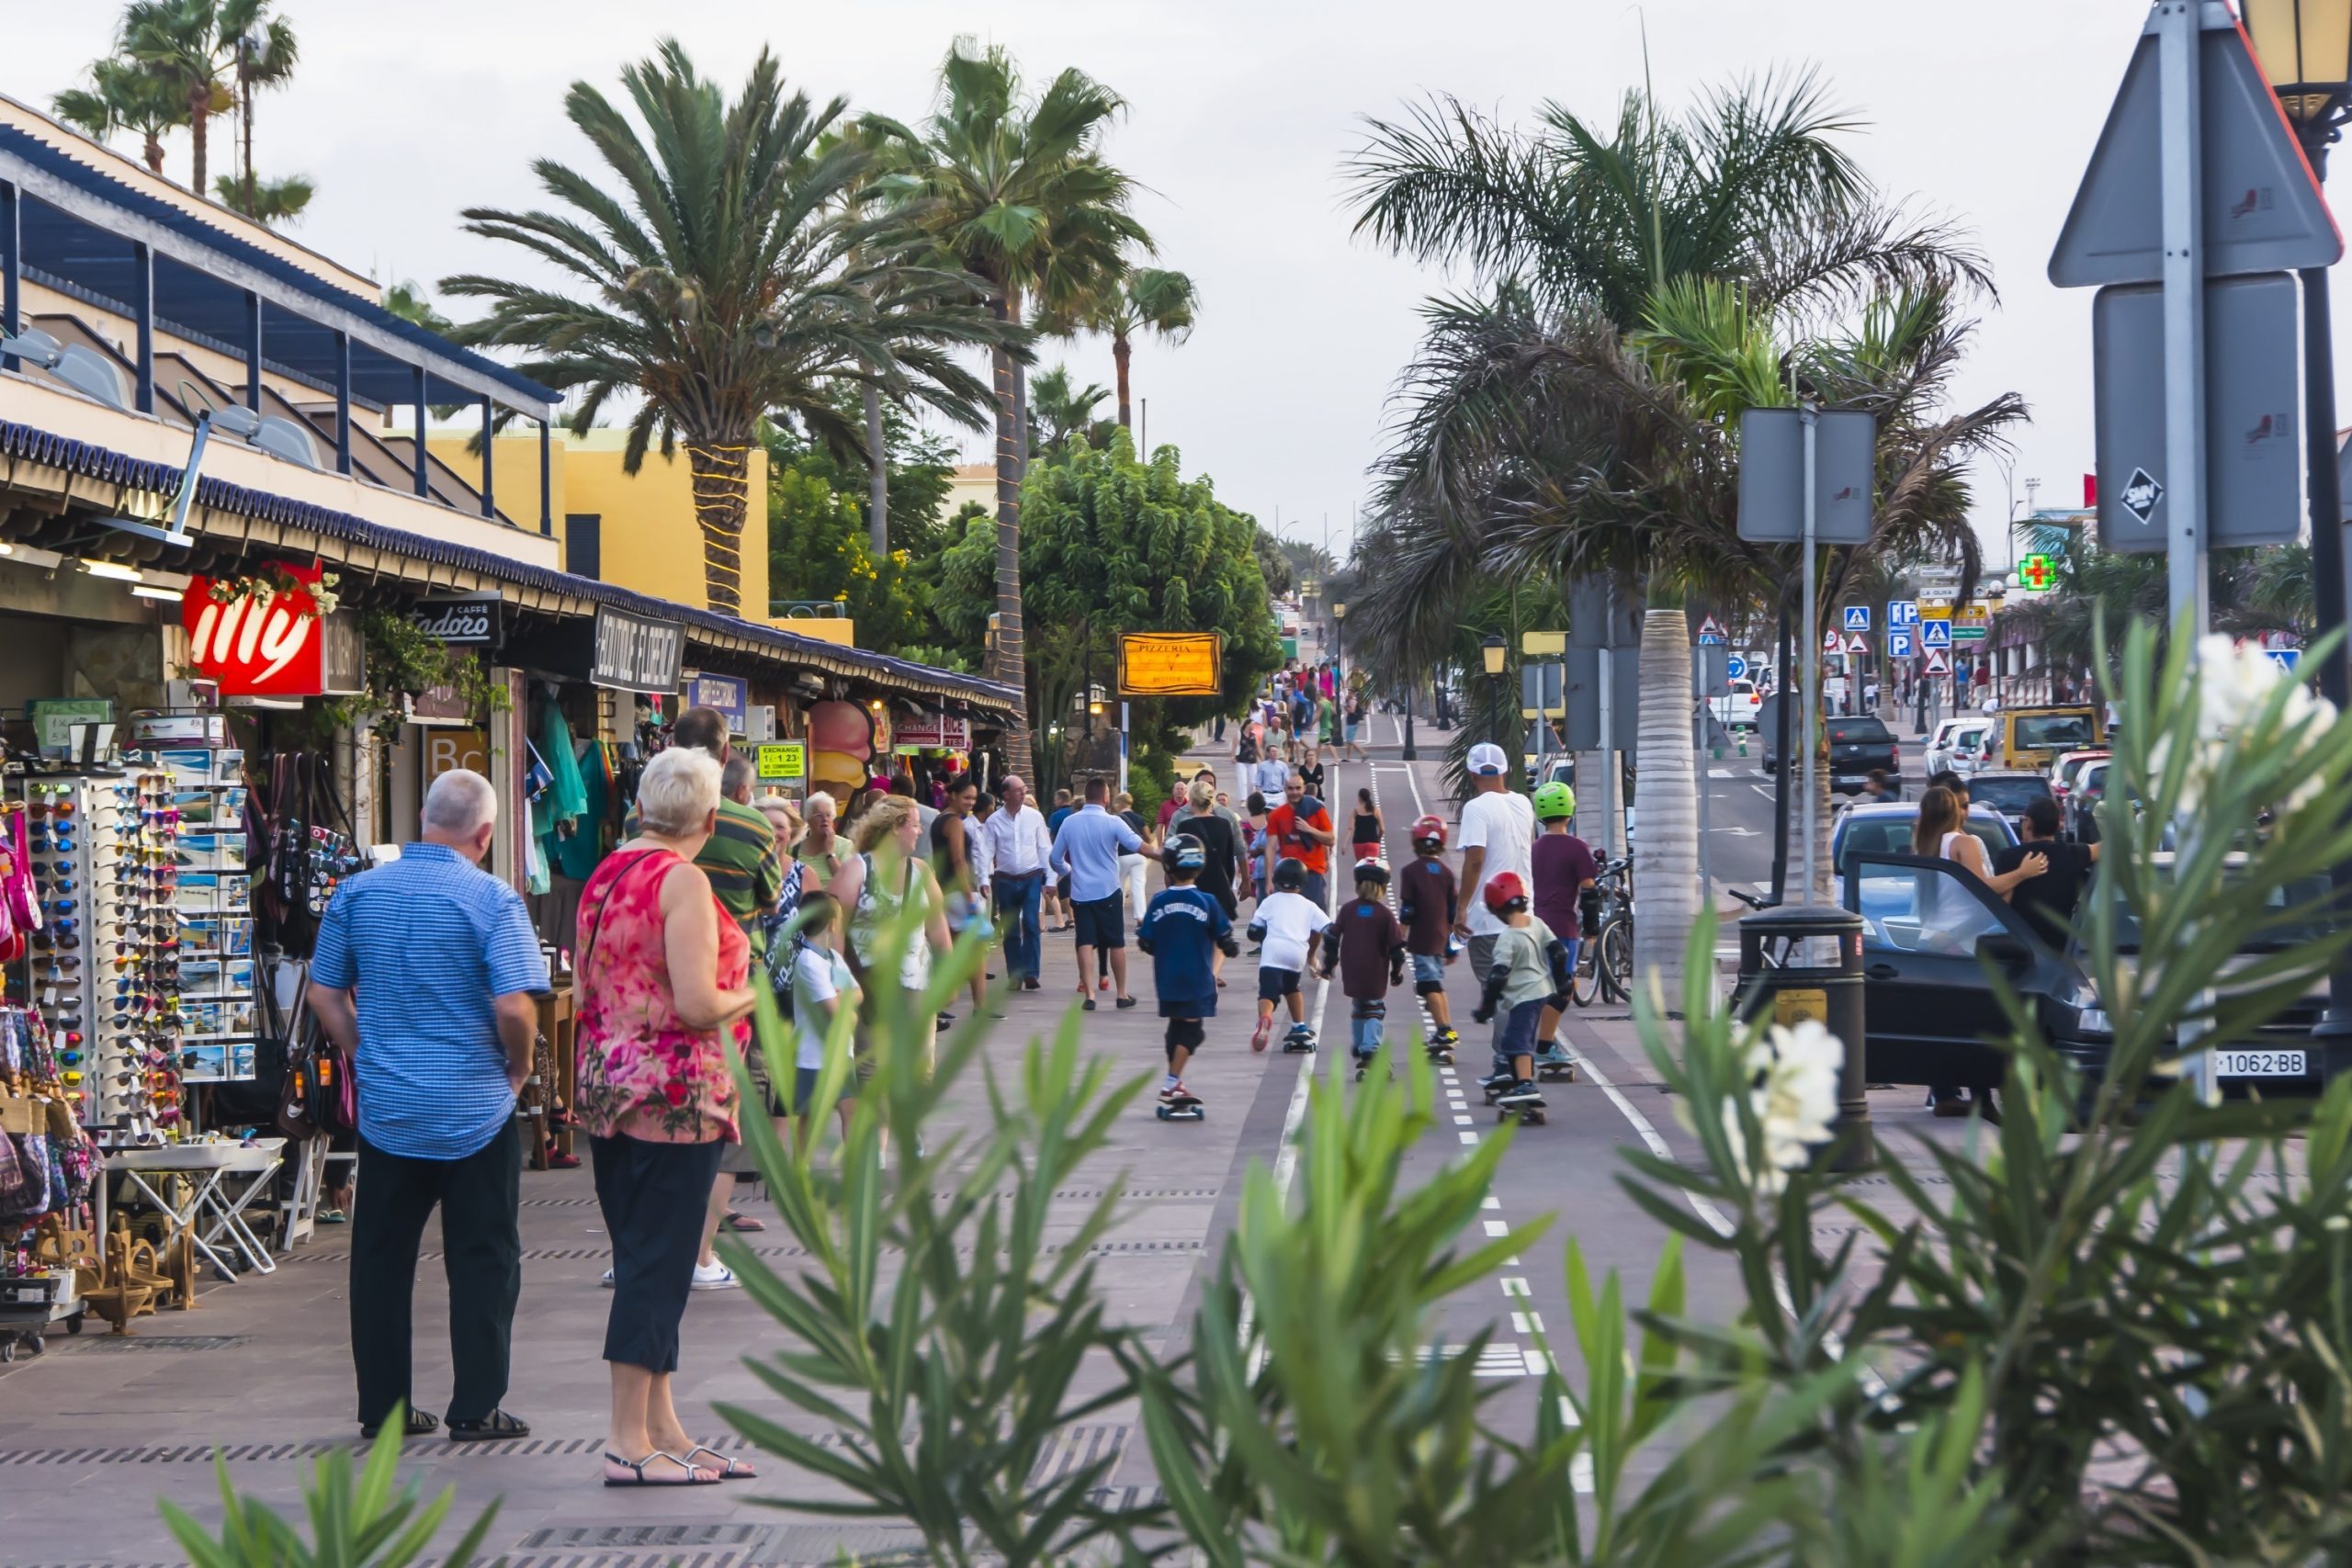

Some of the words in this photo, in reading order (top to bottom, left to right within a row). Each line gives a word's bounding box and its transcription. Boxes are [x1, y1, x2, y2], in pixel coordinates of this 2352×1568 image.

[190, 586, 313, 684] illy
[1139, 644, 1191, 653] PIZZERIA
[897, 723, 939, 732] CHANGE
